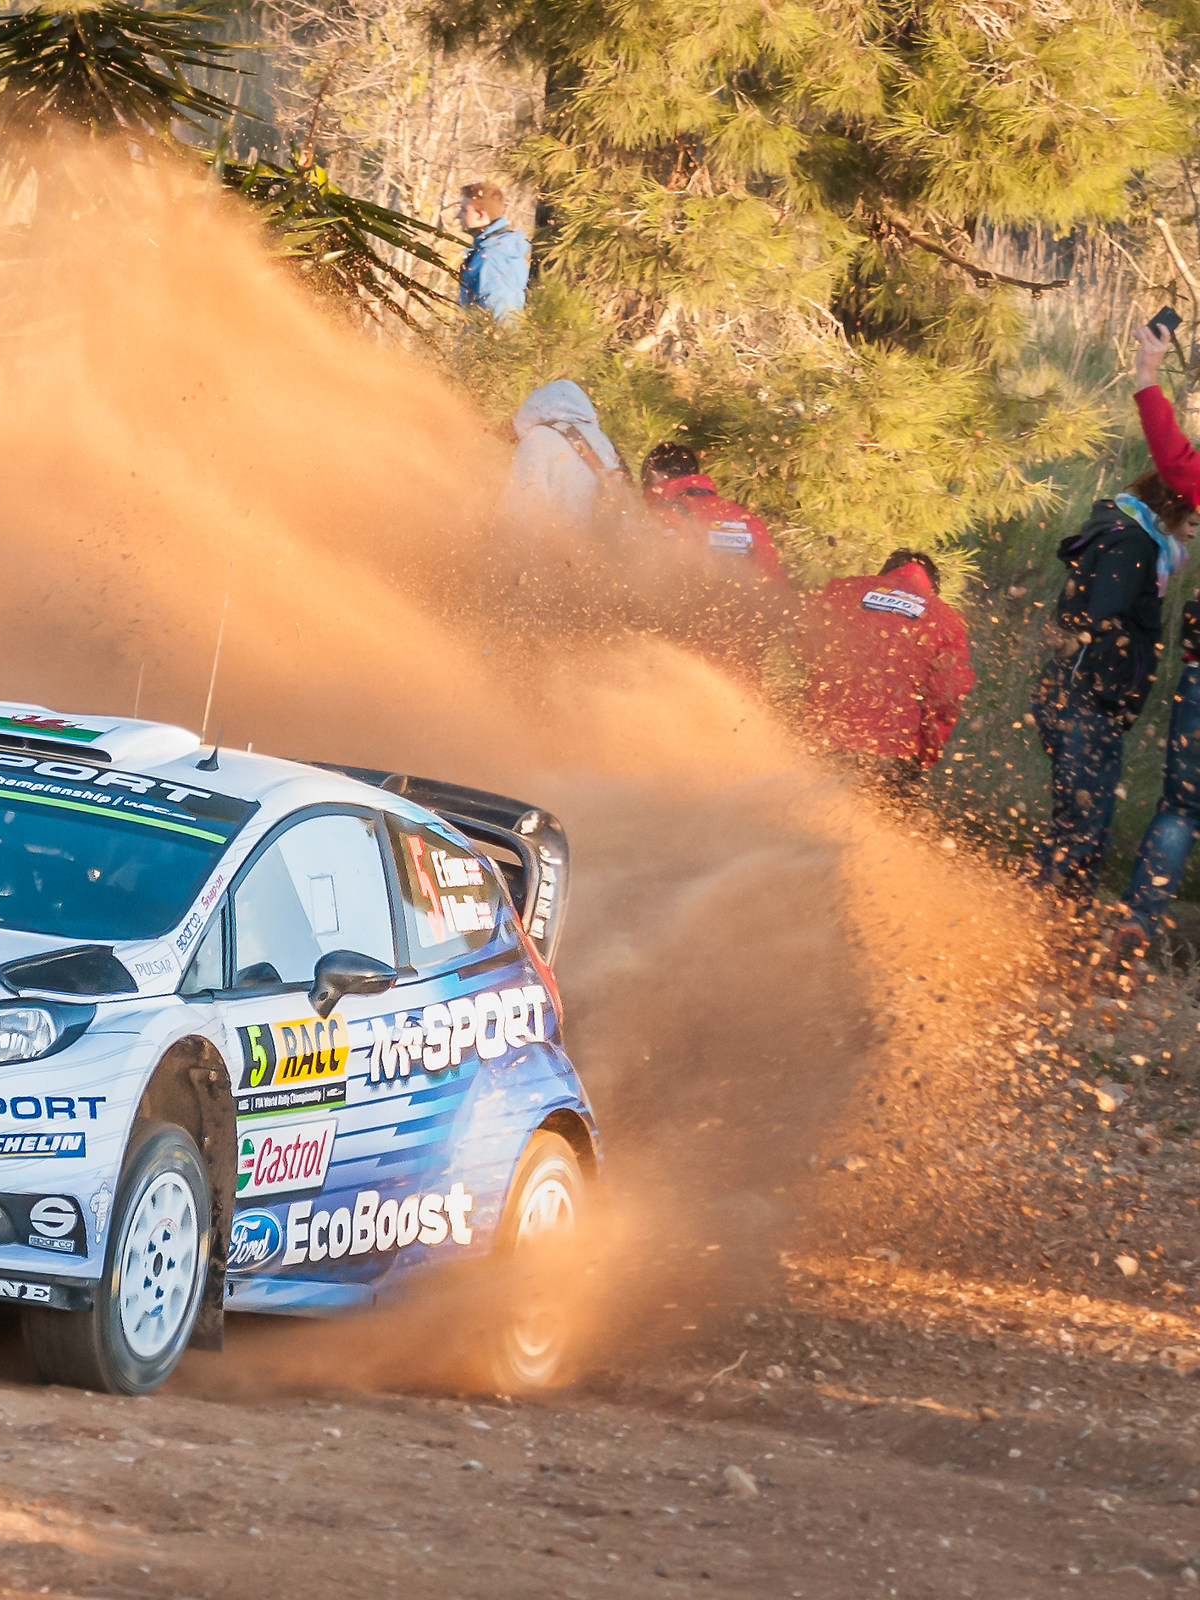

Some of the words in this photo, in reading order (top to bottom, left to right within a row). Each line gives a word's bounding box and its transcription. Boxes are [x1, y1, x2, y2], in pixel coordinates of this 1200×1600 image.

[134, 959, 174, 977] PULSAR
[248, 1024, 268, 1087] 5
[281, 1018, 341, 1079] RACC
[370, 984, 548, 1083] M-SPORT
[254, 1129, 328, 1187] Castrol
[228, 1219, 271, 1265] Ford
[281, 1182, 474, 1267] EcoBoost
